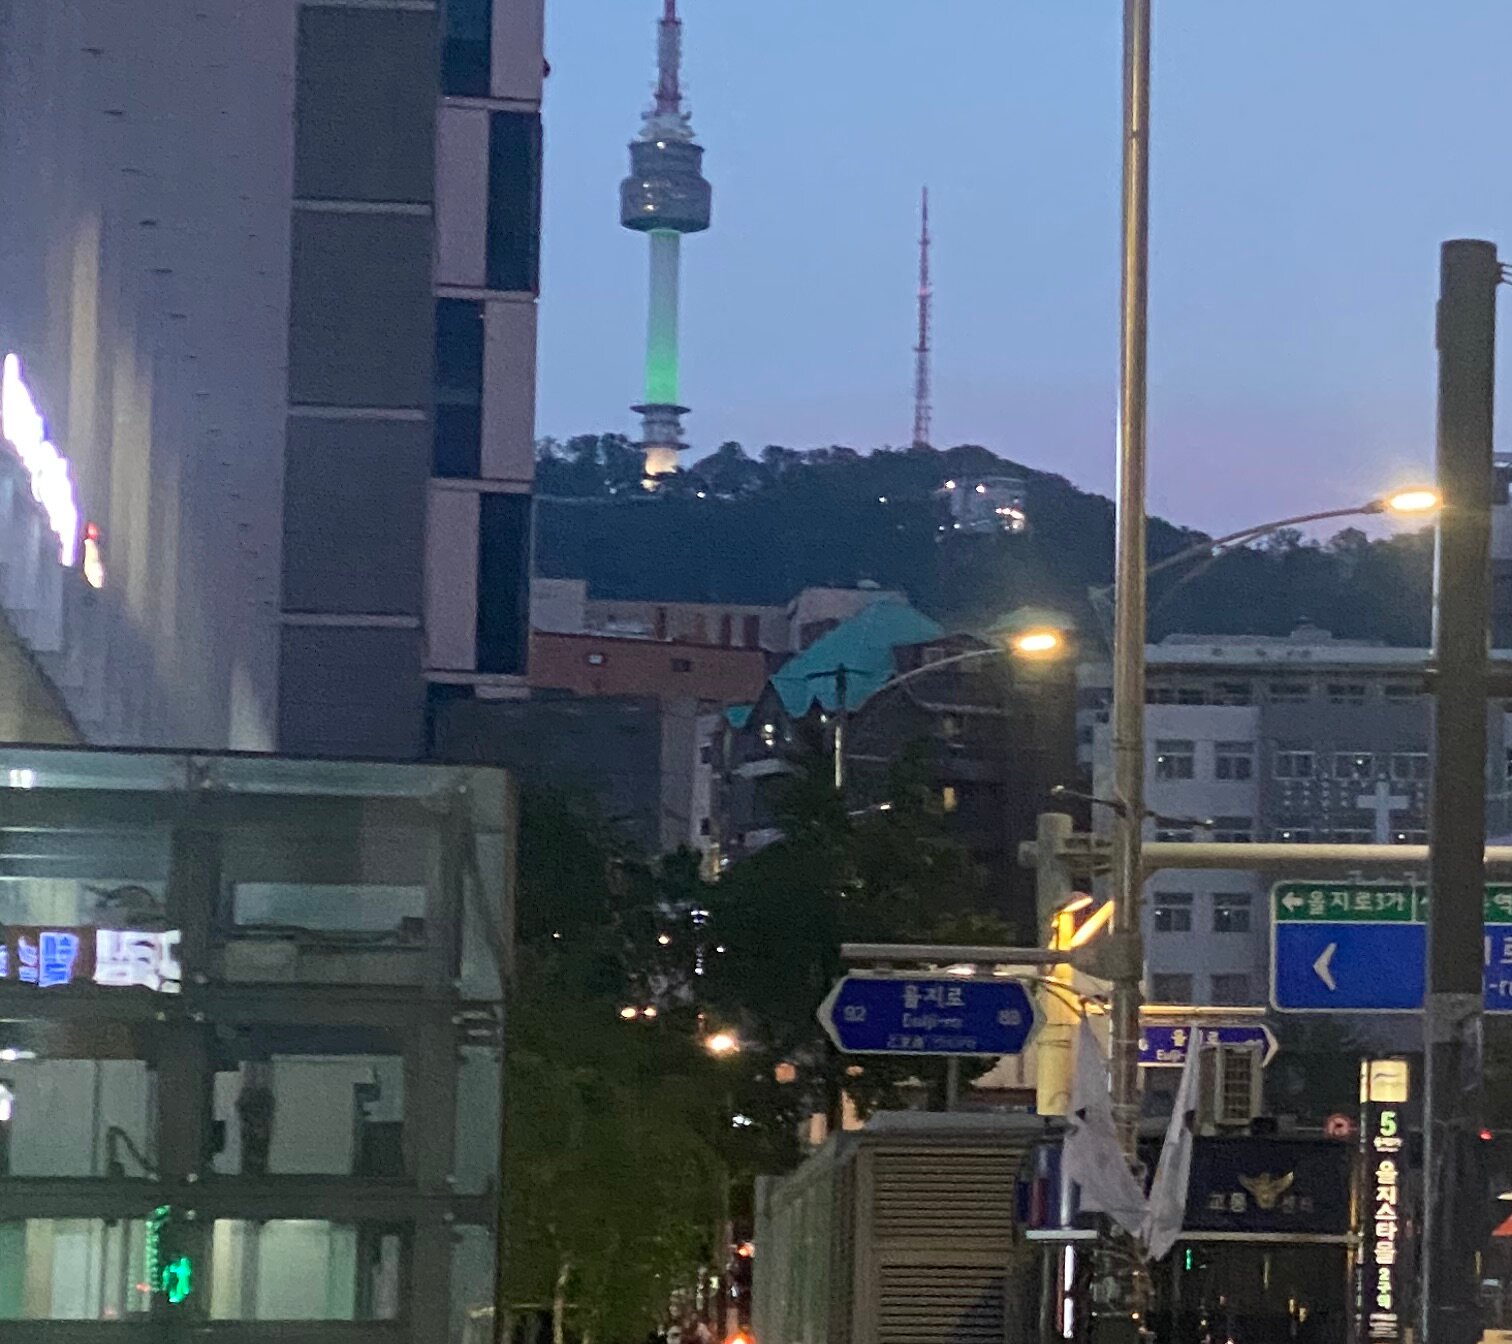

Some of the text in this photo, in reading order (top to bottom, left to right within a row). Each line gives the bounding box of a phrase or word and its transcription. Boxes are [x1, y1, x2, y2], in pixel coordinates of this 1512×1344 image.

[1307, 890, 1406, 916] 을지로3가
[903, 984, 966, 1009] 을지로
[1379, 1110, 1398, 1137] 5
